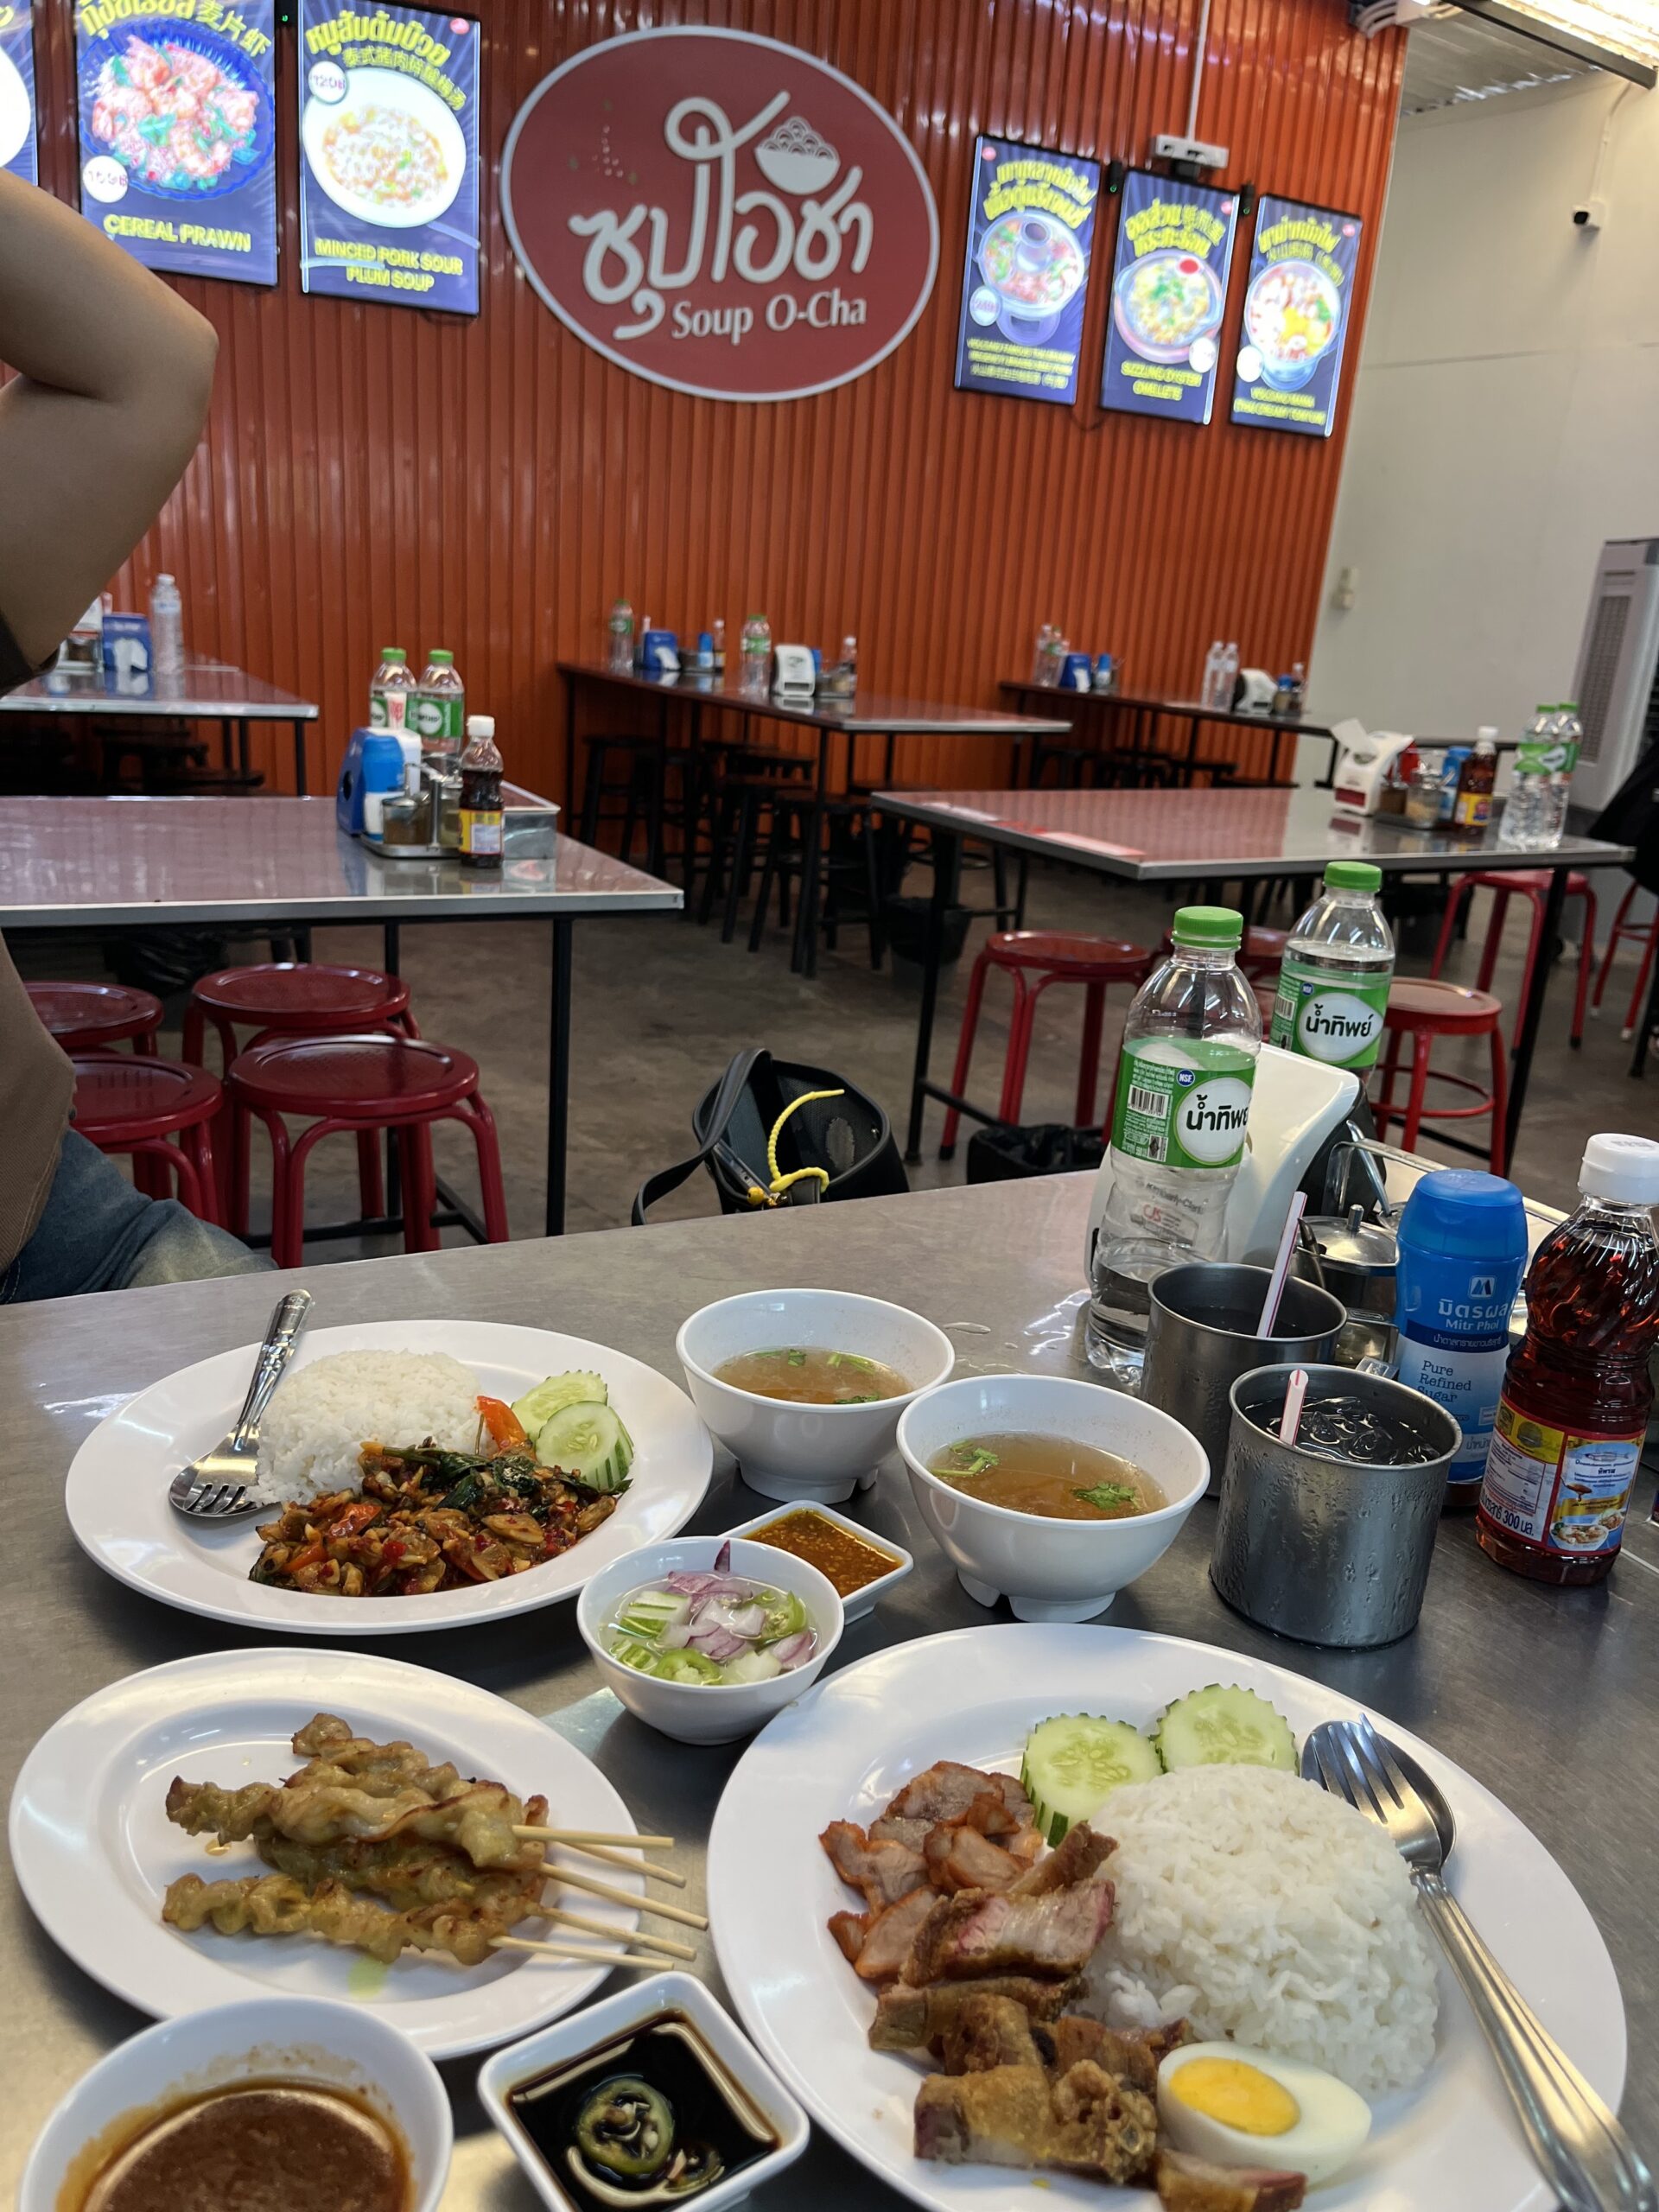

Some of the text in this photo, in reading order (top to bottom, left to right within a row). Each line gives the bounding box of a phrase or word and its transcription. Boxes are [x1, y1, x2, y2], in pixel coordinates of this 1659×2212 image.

[567, 90, 874, 340] ซุปโอชา
[103, 214, 251, 252] CEREAL PRAWN
[315, 238, 463, 275] MINCED PORK SOUR
[346, 266, 435, 292] PLUM SOUP
[671, 288, 868, 346] Soup O-Cha
[1306, 1003, 1374, 1038] น้ำทิพย์
[1185, 1094, 1249, 1131] น้ำทิพย
[1439, 1299, 1510, 1319] มิตรผล
[1446, 1319, 1499, 1332] Mitr Phol
[1421, 1360, 1453, 1376] Pure
[1417, 1385, 1457, 1403] Sugar
[1419, 1373, 1471, 1391] Refined
[1503, 1508, 1520, 1530] 300
